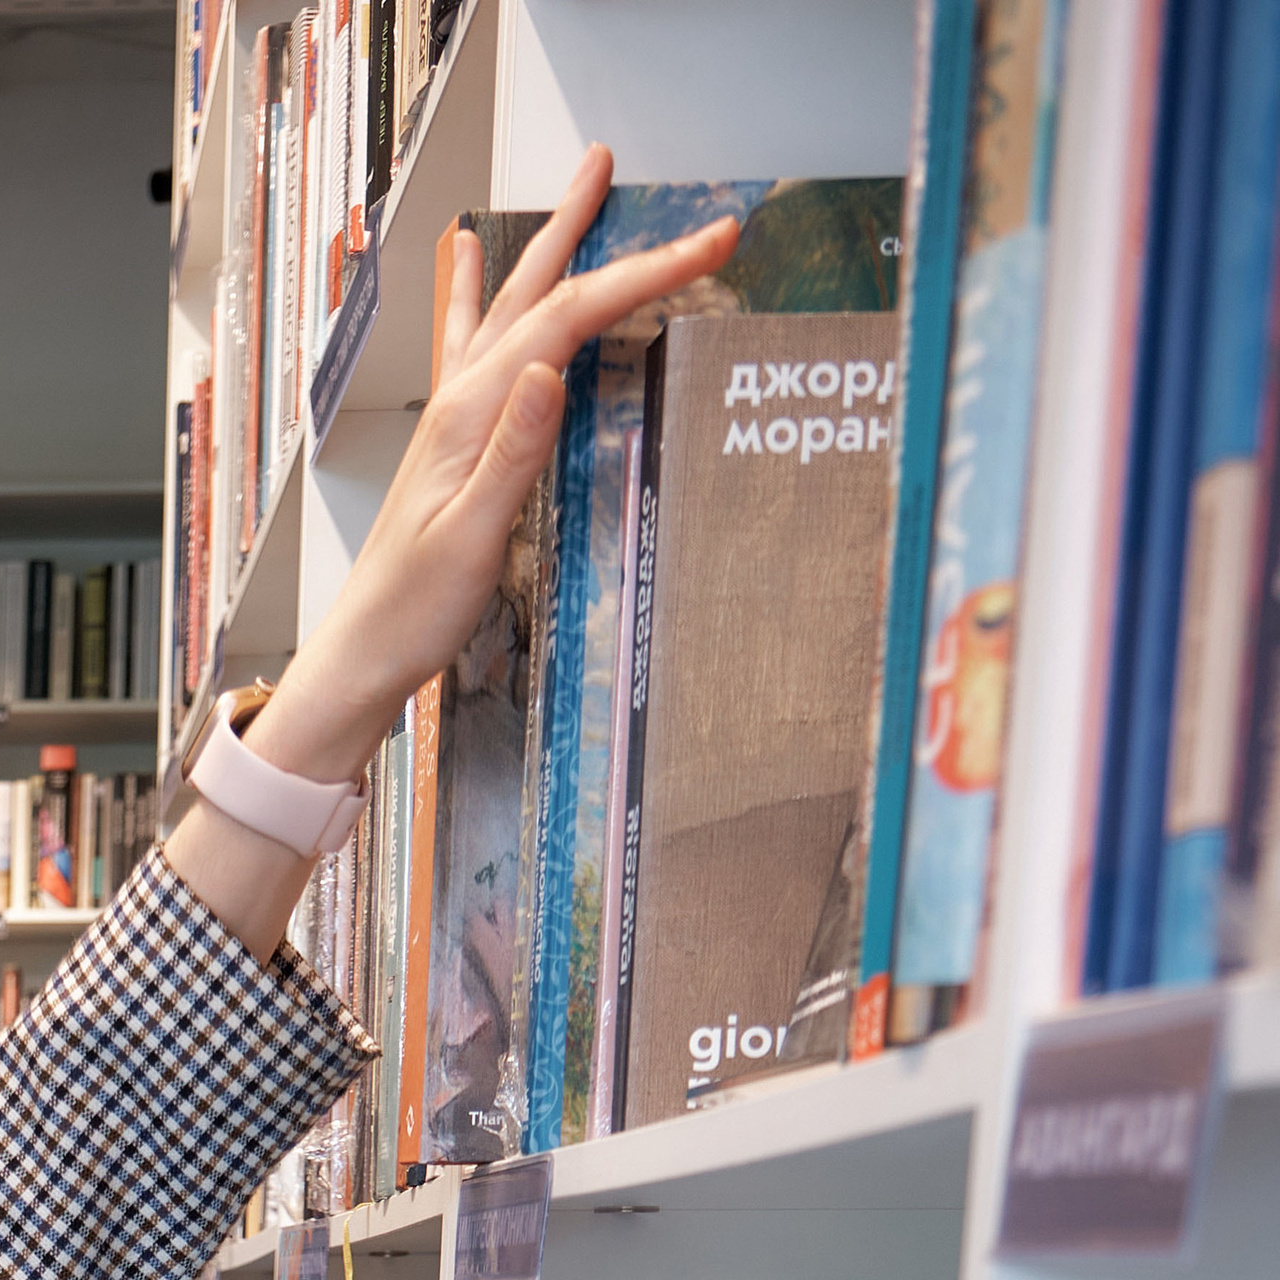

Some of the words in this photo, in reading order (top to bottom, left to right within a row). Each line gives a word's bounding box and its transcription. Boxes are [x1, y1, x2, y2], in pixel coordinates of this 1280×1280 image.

[633, 485, 651, 711] джорджо
[640, 496, 657, 703] моранди
[416, 690, 428, 817] OPERA
[426, 681, 440, 777] GAS
[539, 747, 552, 822] ЖИЗНЬ
[532, 848, 547, 983] ТВОРЧЕСТВО
[620, 809, 634, 985] morandi
